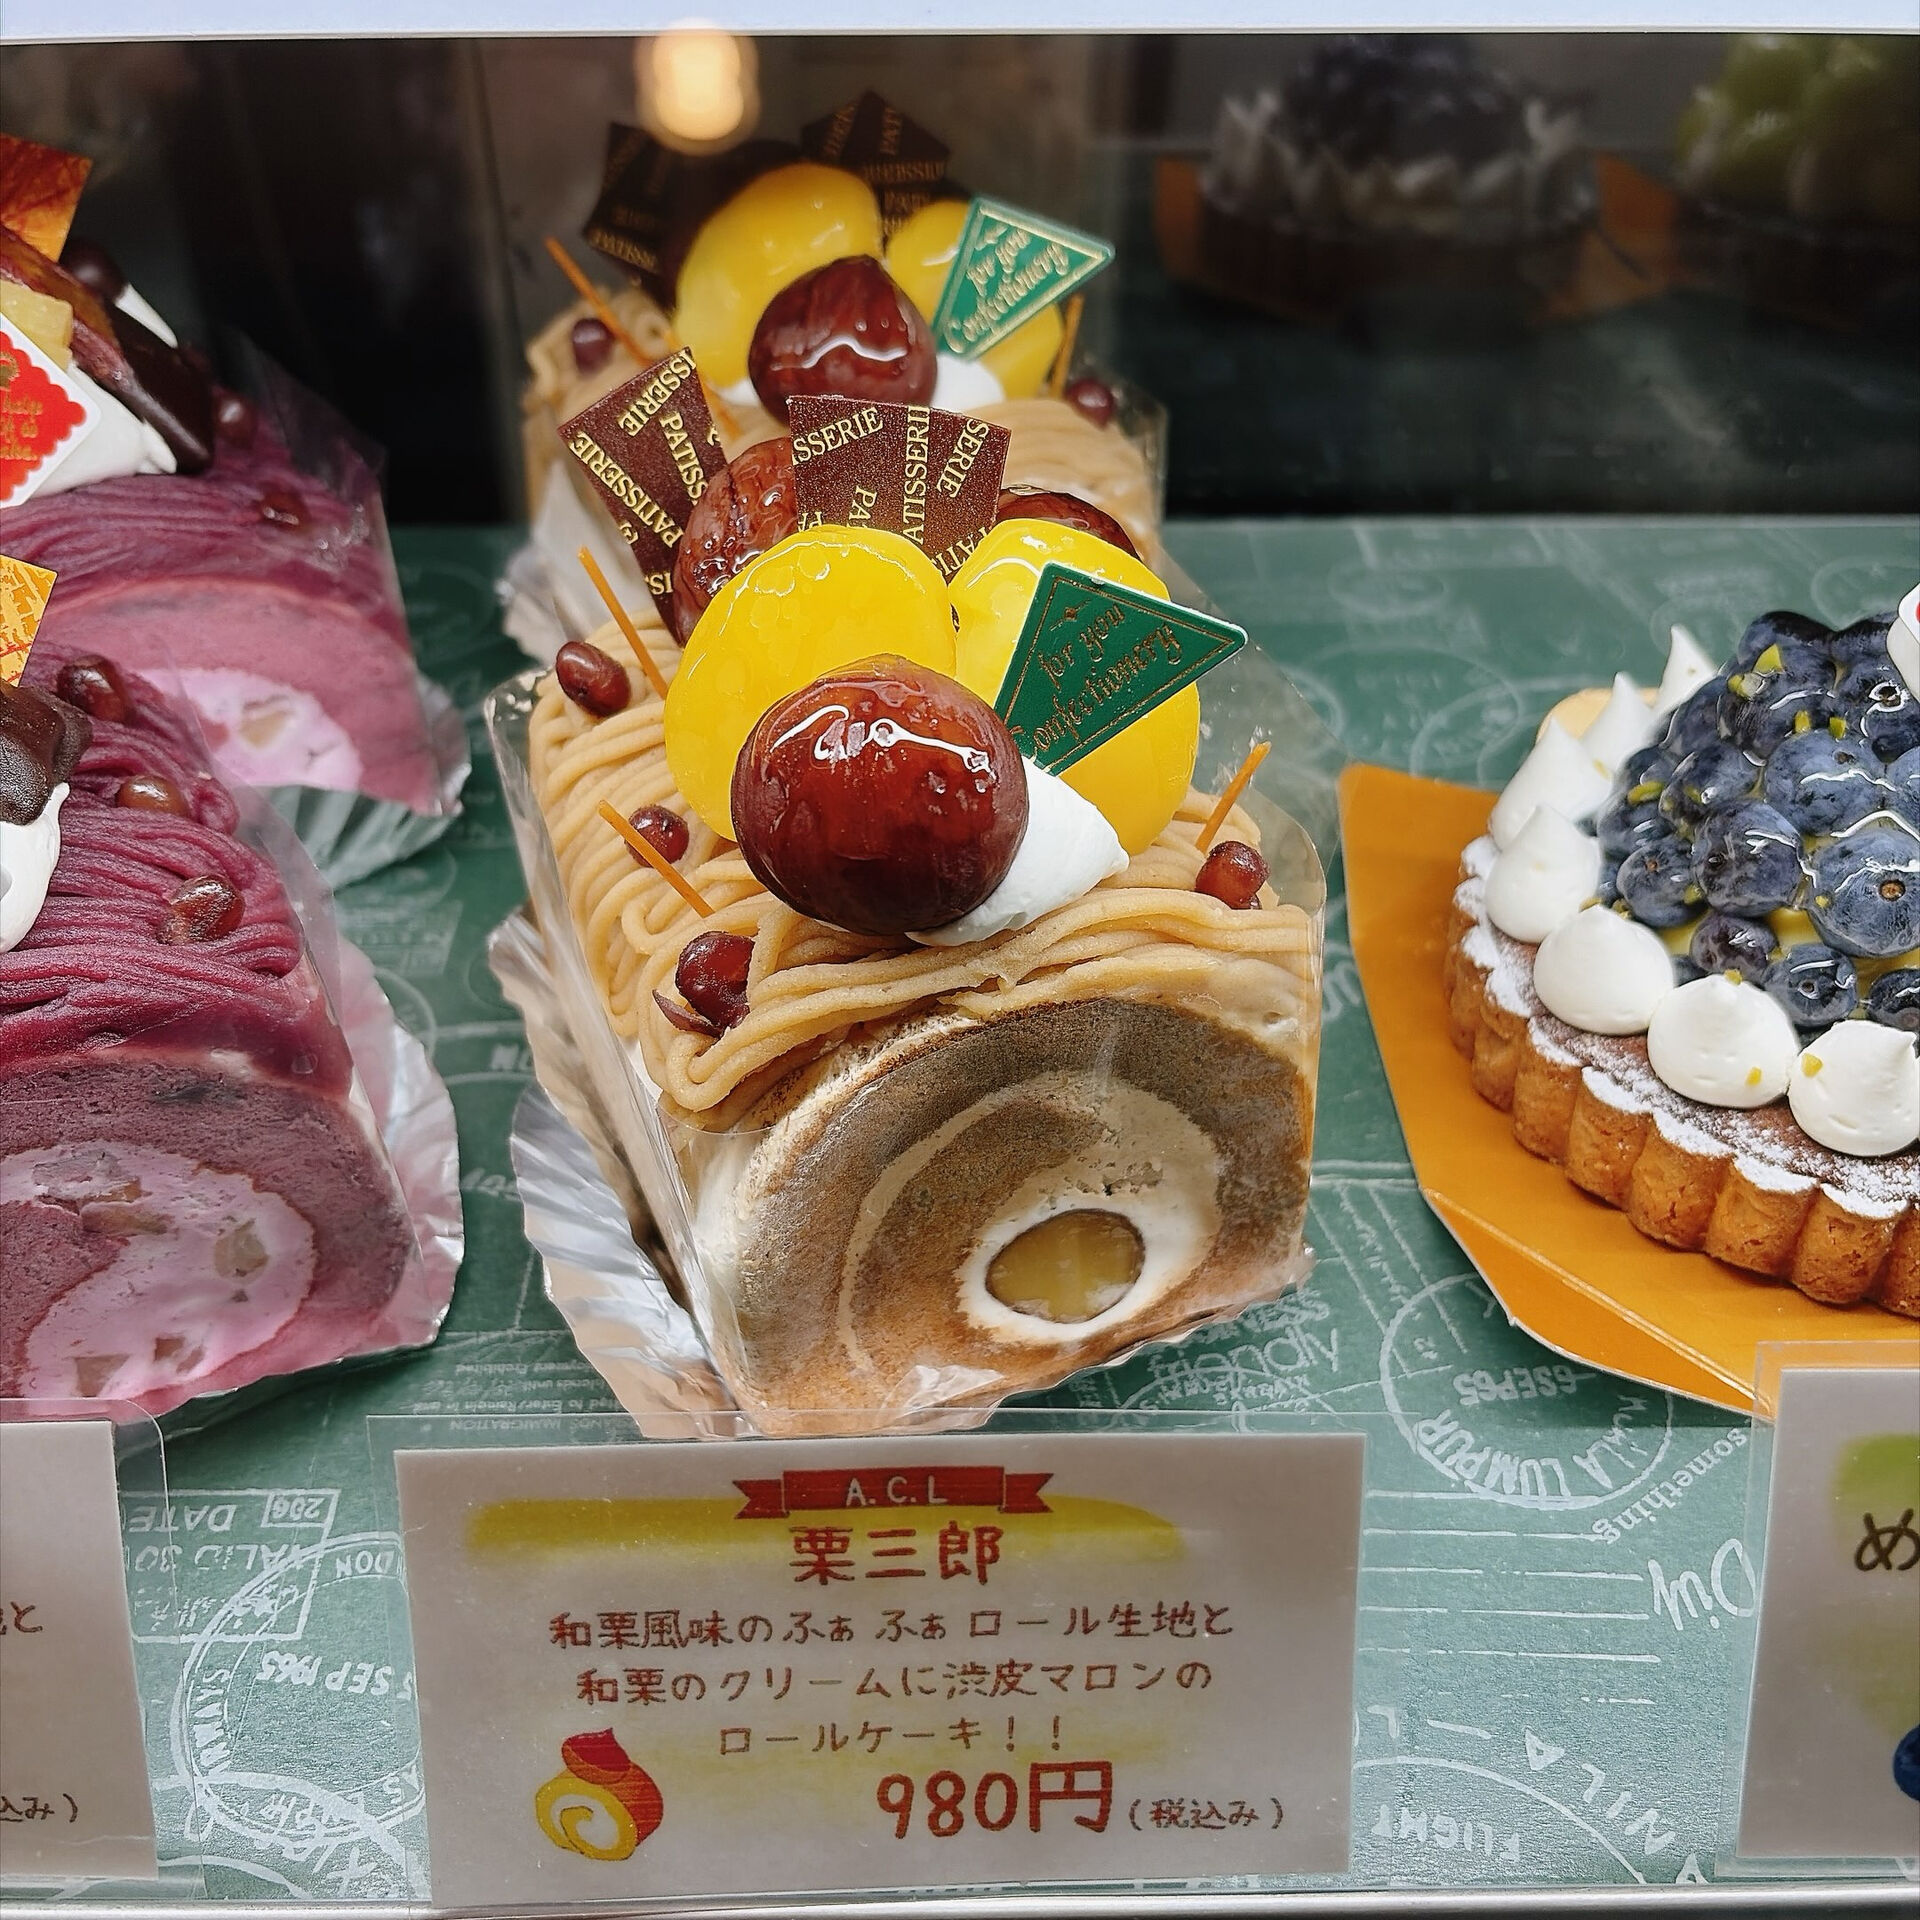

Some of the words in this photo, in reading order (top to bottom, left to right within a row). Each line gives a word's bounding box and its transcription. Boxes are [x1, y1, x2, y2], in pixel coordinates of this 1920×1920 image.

[569, 432, 684, 548] PATISSERIE
[658, 410, 709, 506] PATISS
[1037, 642, 1075, 692] for
[1080, 602, 1126, 663] you
[845, 1475, 948, 1507] A.C.L
[1590, 1426, 1749, 1545] something
[788, 1519, 1004, 1585] 栗三郎
[1853, 1508, 1920, 1572] め
[0, 1600, 43, 1636] と
[323, 1659, 394, 1696] SEP
[576, 1658, 1213, 1706] 和栗のクリームに渋皮マロンの
[876, 1760, 1113, 1840] 980円
[1129, 1797, 1284, 1833] （税込み）
[1371, 1804, 1521, 1863] FLIGHT
